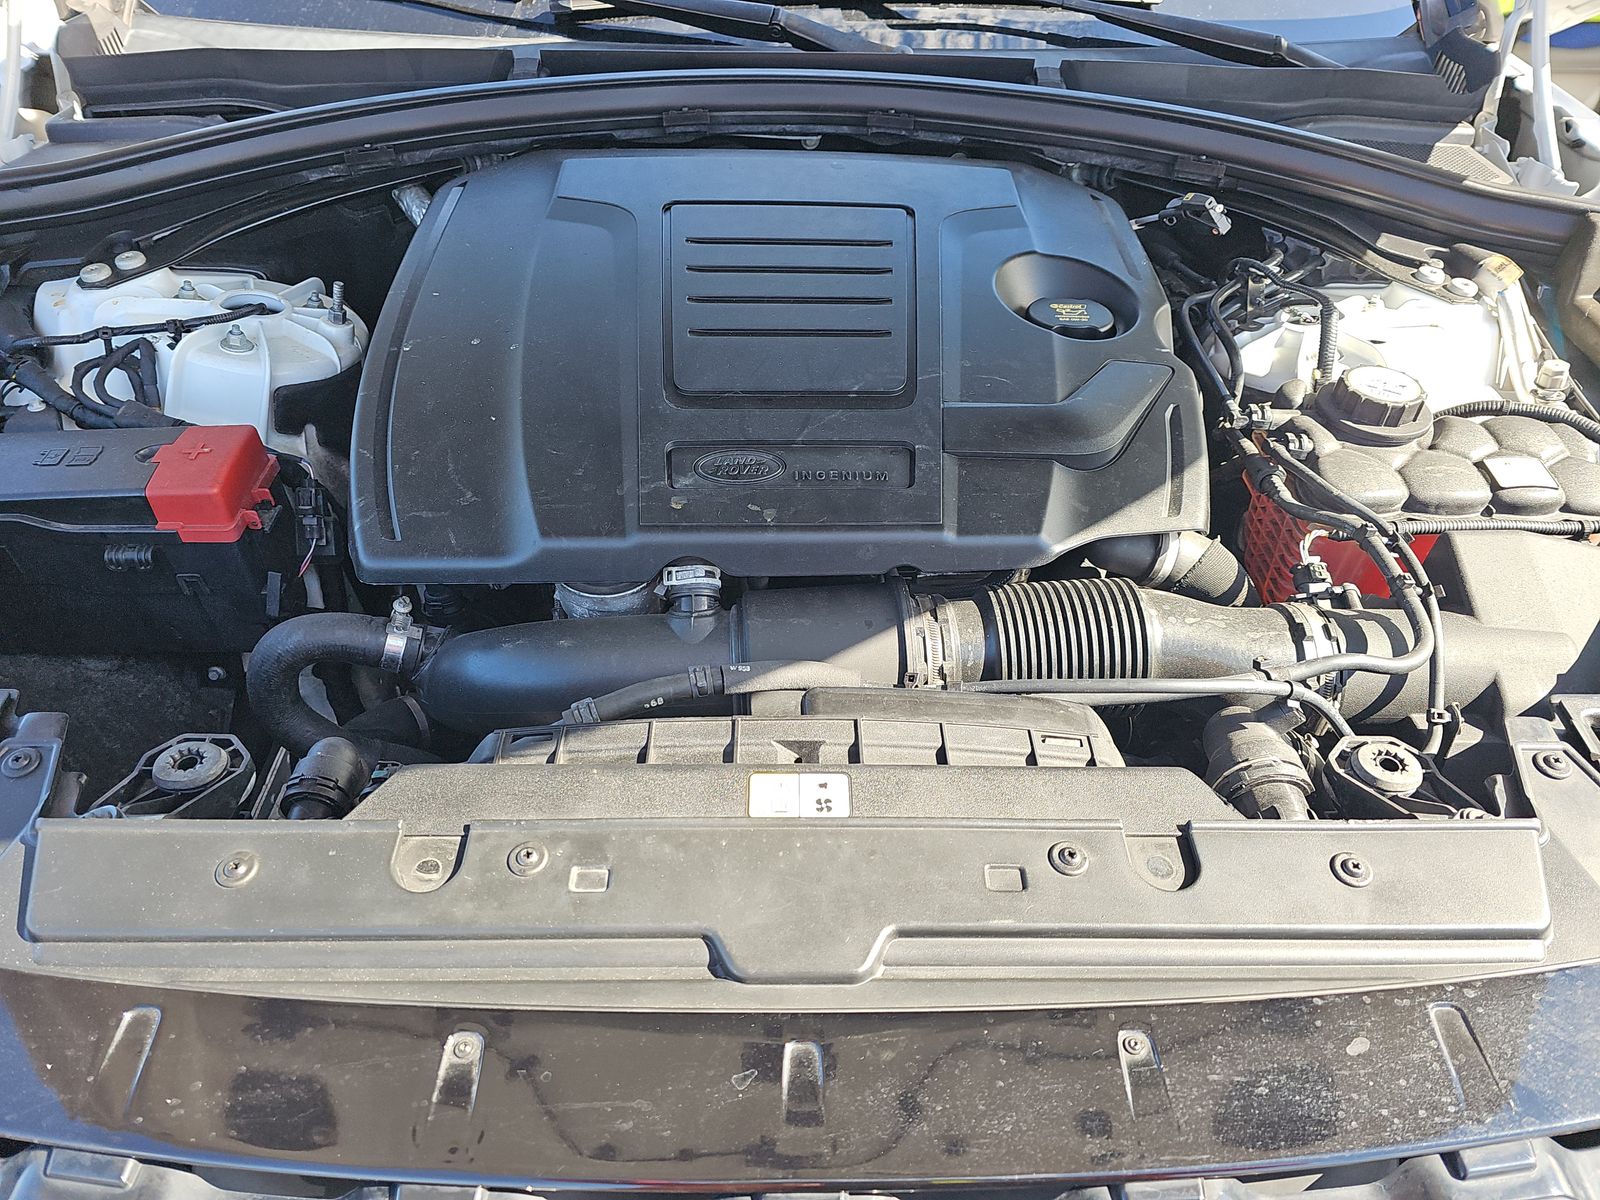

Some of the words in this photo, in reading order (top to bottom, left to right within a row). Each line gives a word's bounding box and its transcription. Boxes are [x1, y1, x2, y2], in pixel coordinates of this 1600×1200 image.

[714, 457, 759, 465] LAND
[717, 465, 770, 476] ROVER
[794, 470, 889, 481] INGENIUM
